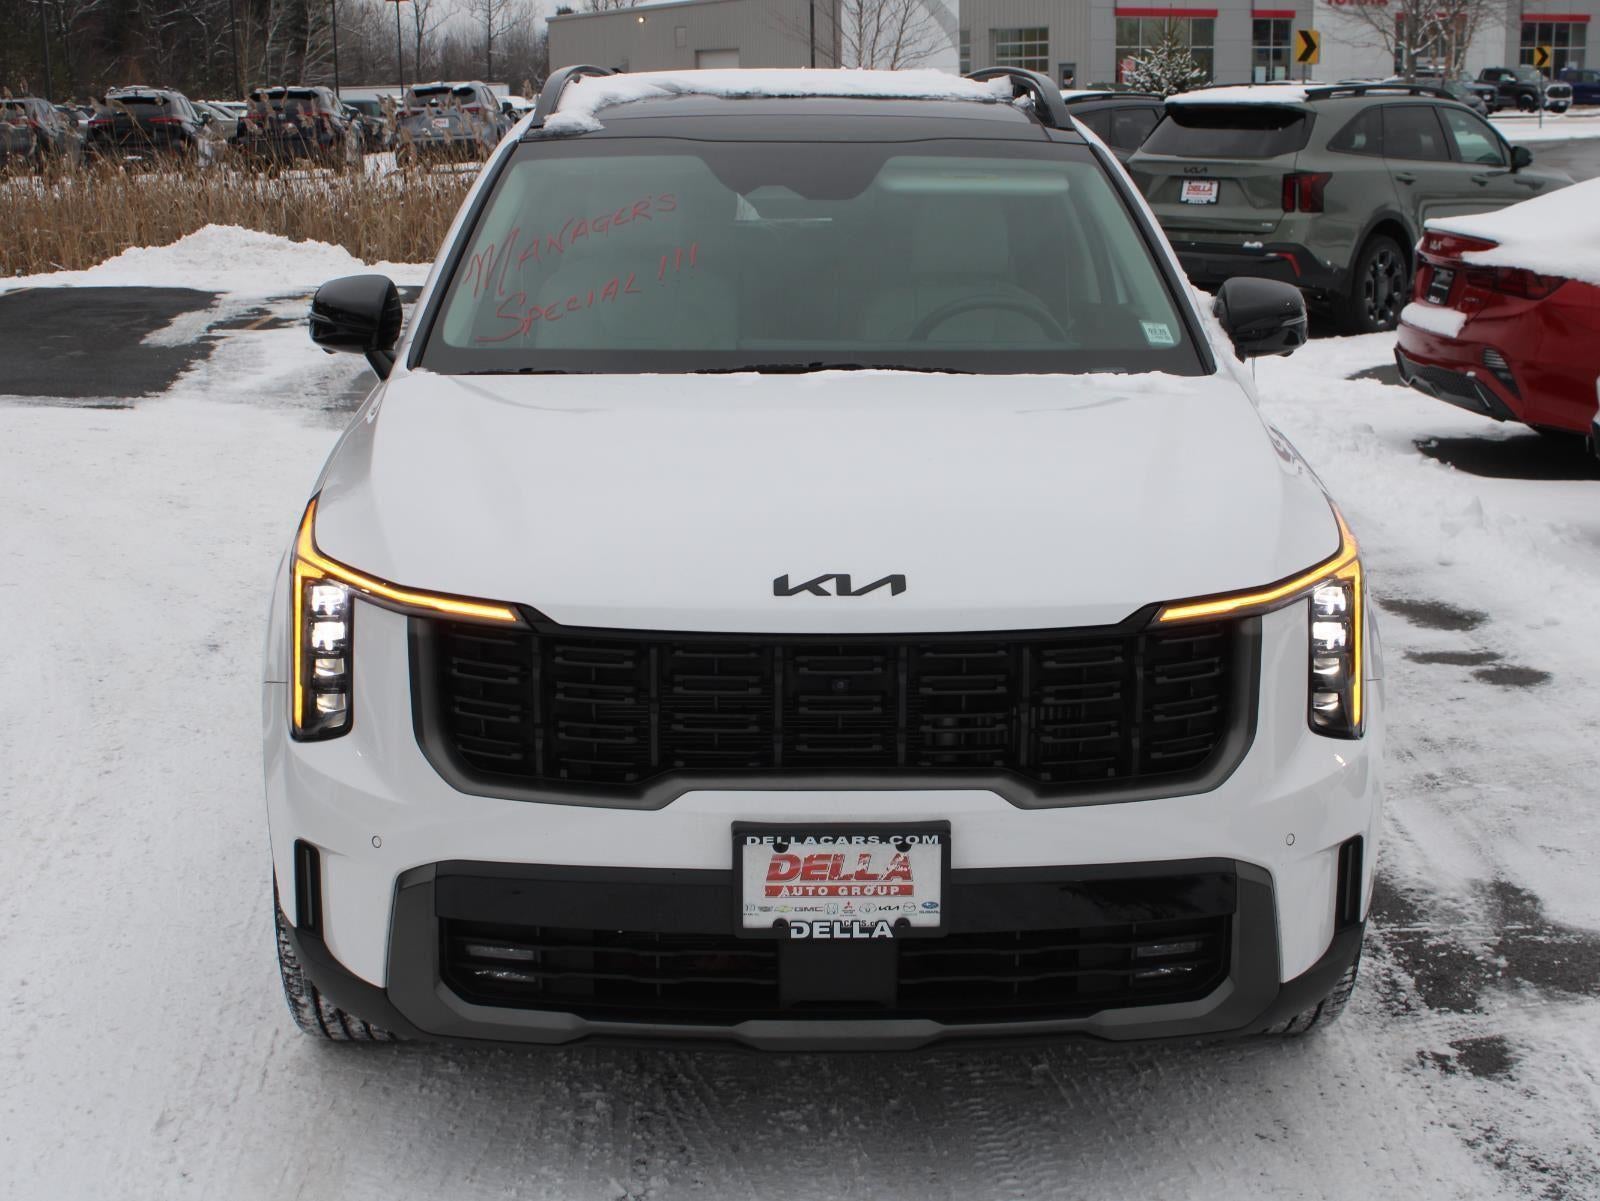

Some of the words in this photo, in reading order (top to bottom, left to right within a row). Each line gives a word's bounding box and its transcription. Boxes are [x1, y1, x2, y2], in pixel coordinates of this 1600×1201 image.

[773, 573, 907, 597] KIA
[746, 835, 939, 845] DELLACARS.COM
[765, 853, 913, 881] DELLA
[780, 886, 829, 896] AUTO
[838, 886, 901, 896] GROUP
[790, 921, 894, 939] DELLA
